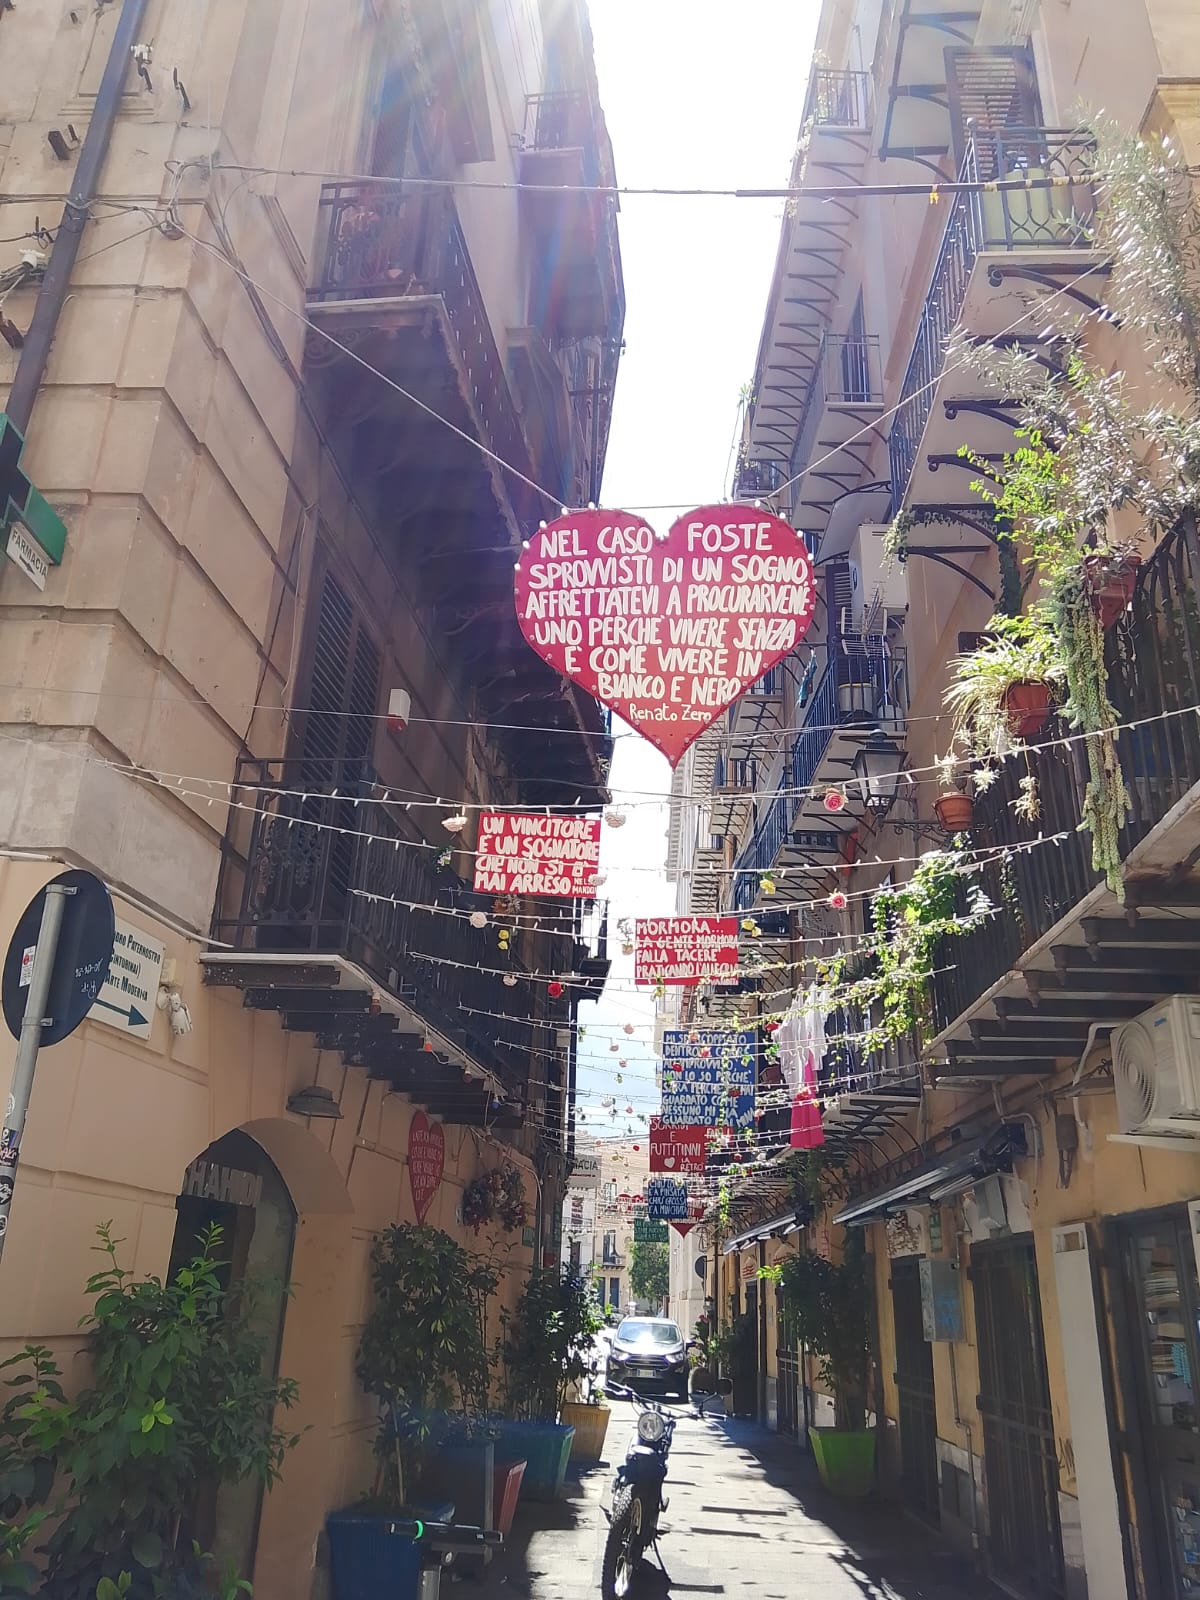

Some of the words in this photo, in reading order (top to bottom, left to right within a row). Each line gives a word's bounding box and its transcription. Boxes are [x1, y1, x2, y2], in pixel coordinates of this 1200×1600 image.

[540, 529, 587, 558] NEL
[597, 526, 654, 554] CASO
[688, 522, 773, 552] FOSTE
[11, 529, 48, 577] FARMACIA
[528, 556, 652, 588] SPROVVISTI
[662, 557, 684, 583] DI
[692, 557, 723, 583] UN
[525, 586, 659, 619] AFFRETTATEVI
[666, 586, 681, 615] A
[686, 584, 811, 615] PROCURARVENE
[534, 622, 583, 646] UNO
[669, 618, 729, 648] VIVERE
[733, 618, 796, 650] SENZA
[589, 646, 648, 674] COME
[657, 647, 729, 676] VIVERE
[736, 651, 763, 677] IN
[597, 673, 665, 700] BIANCO
[670, 676, 685, 702] E
[690, 676, 742, 706] NERO
[629, 703, 678, 721] Renato
[681, 703, 712, 722] Zero
[483, 817, 505, 834] UN
[510, 817, 596, 840] VINCITORE
[495, 836, 518, 855] UN
[522, 837, 600, 861] SOGNATORE
[475, 855, 505, 873] CHE
[507, 858, 539, 874] NON
[545, 859, 564, 875] SI
[475, 872, 506, 891] MAI
[510, 873, 572, 895] ARRESO
[114, 932, 126, 946] DRO
[127, 934, 161, 965] PATERNOSTRO
[636, 936, 653, 949] LA
[656, 935, 693, 949] GENTE
[637, 949, 668, 964] FALLA
[675, 949, 718, 962] TACERE
[636, 963, 694, 979] PRATICANDO
[121, 976, 148, 1001] MODERNA
[665, 1045, 699, 1057] DENTRO
[685, 1071, 696, 1082] LO
[698, 1071, 712, 1082] SO
[661, 1105, 701, 1115] NESSUNO
[705, 1105, 716, 1117] MI
[662, 1094, 707, 1106] GUARDATO
[662, 1115, 712, 1126] GUARDATO
[670, 1131, 677, 1142] E
